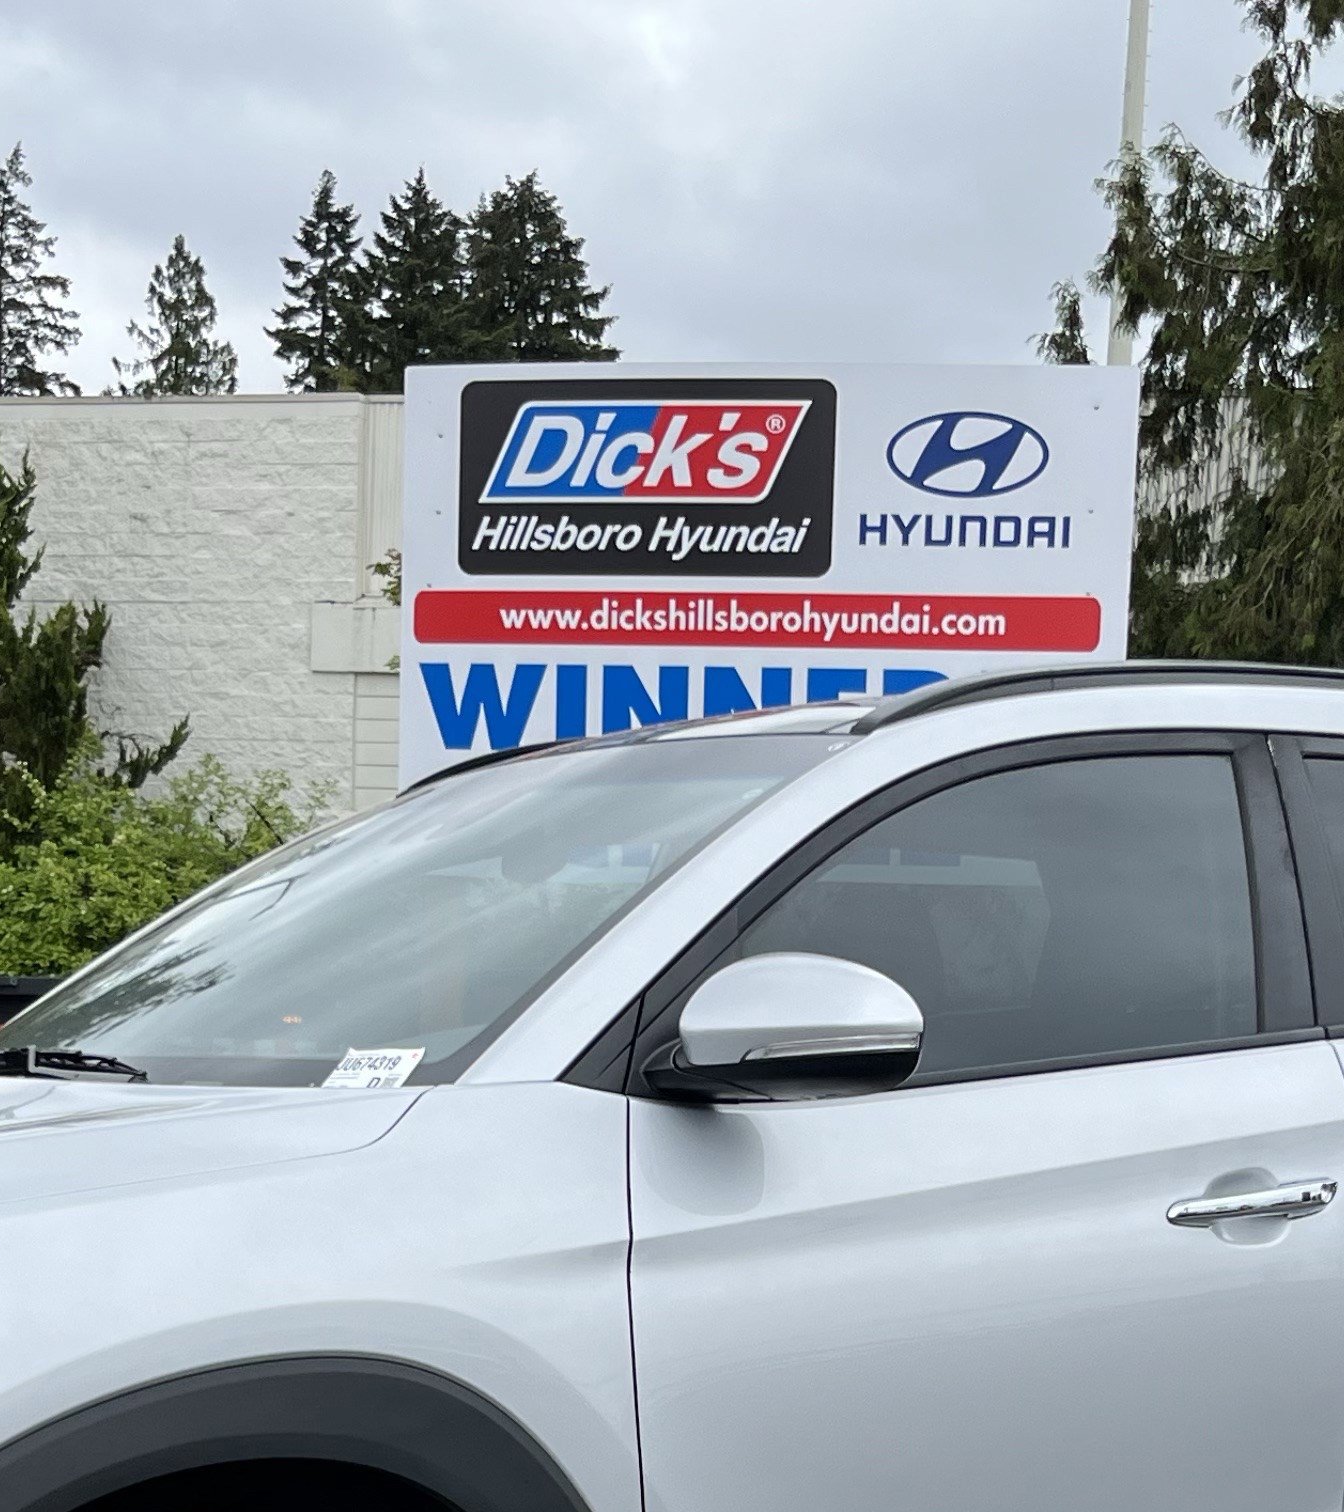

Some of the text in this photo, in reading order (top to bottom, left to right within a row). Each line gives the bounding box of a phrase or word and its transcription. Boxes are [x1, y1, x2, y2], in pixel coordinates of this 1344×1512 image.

[506, 411, 769, 490] Dick's
[471, 515, 812, 560] Hillsboro Hyundai
[859, 513, 1071, 549] HYUNDAI
[499, 600, 1007, 640] www.dickshillsborohyundai.com
